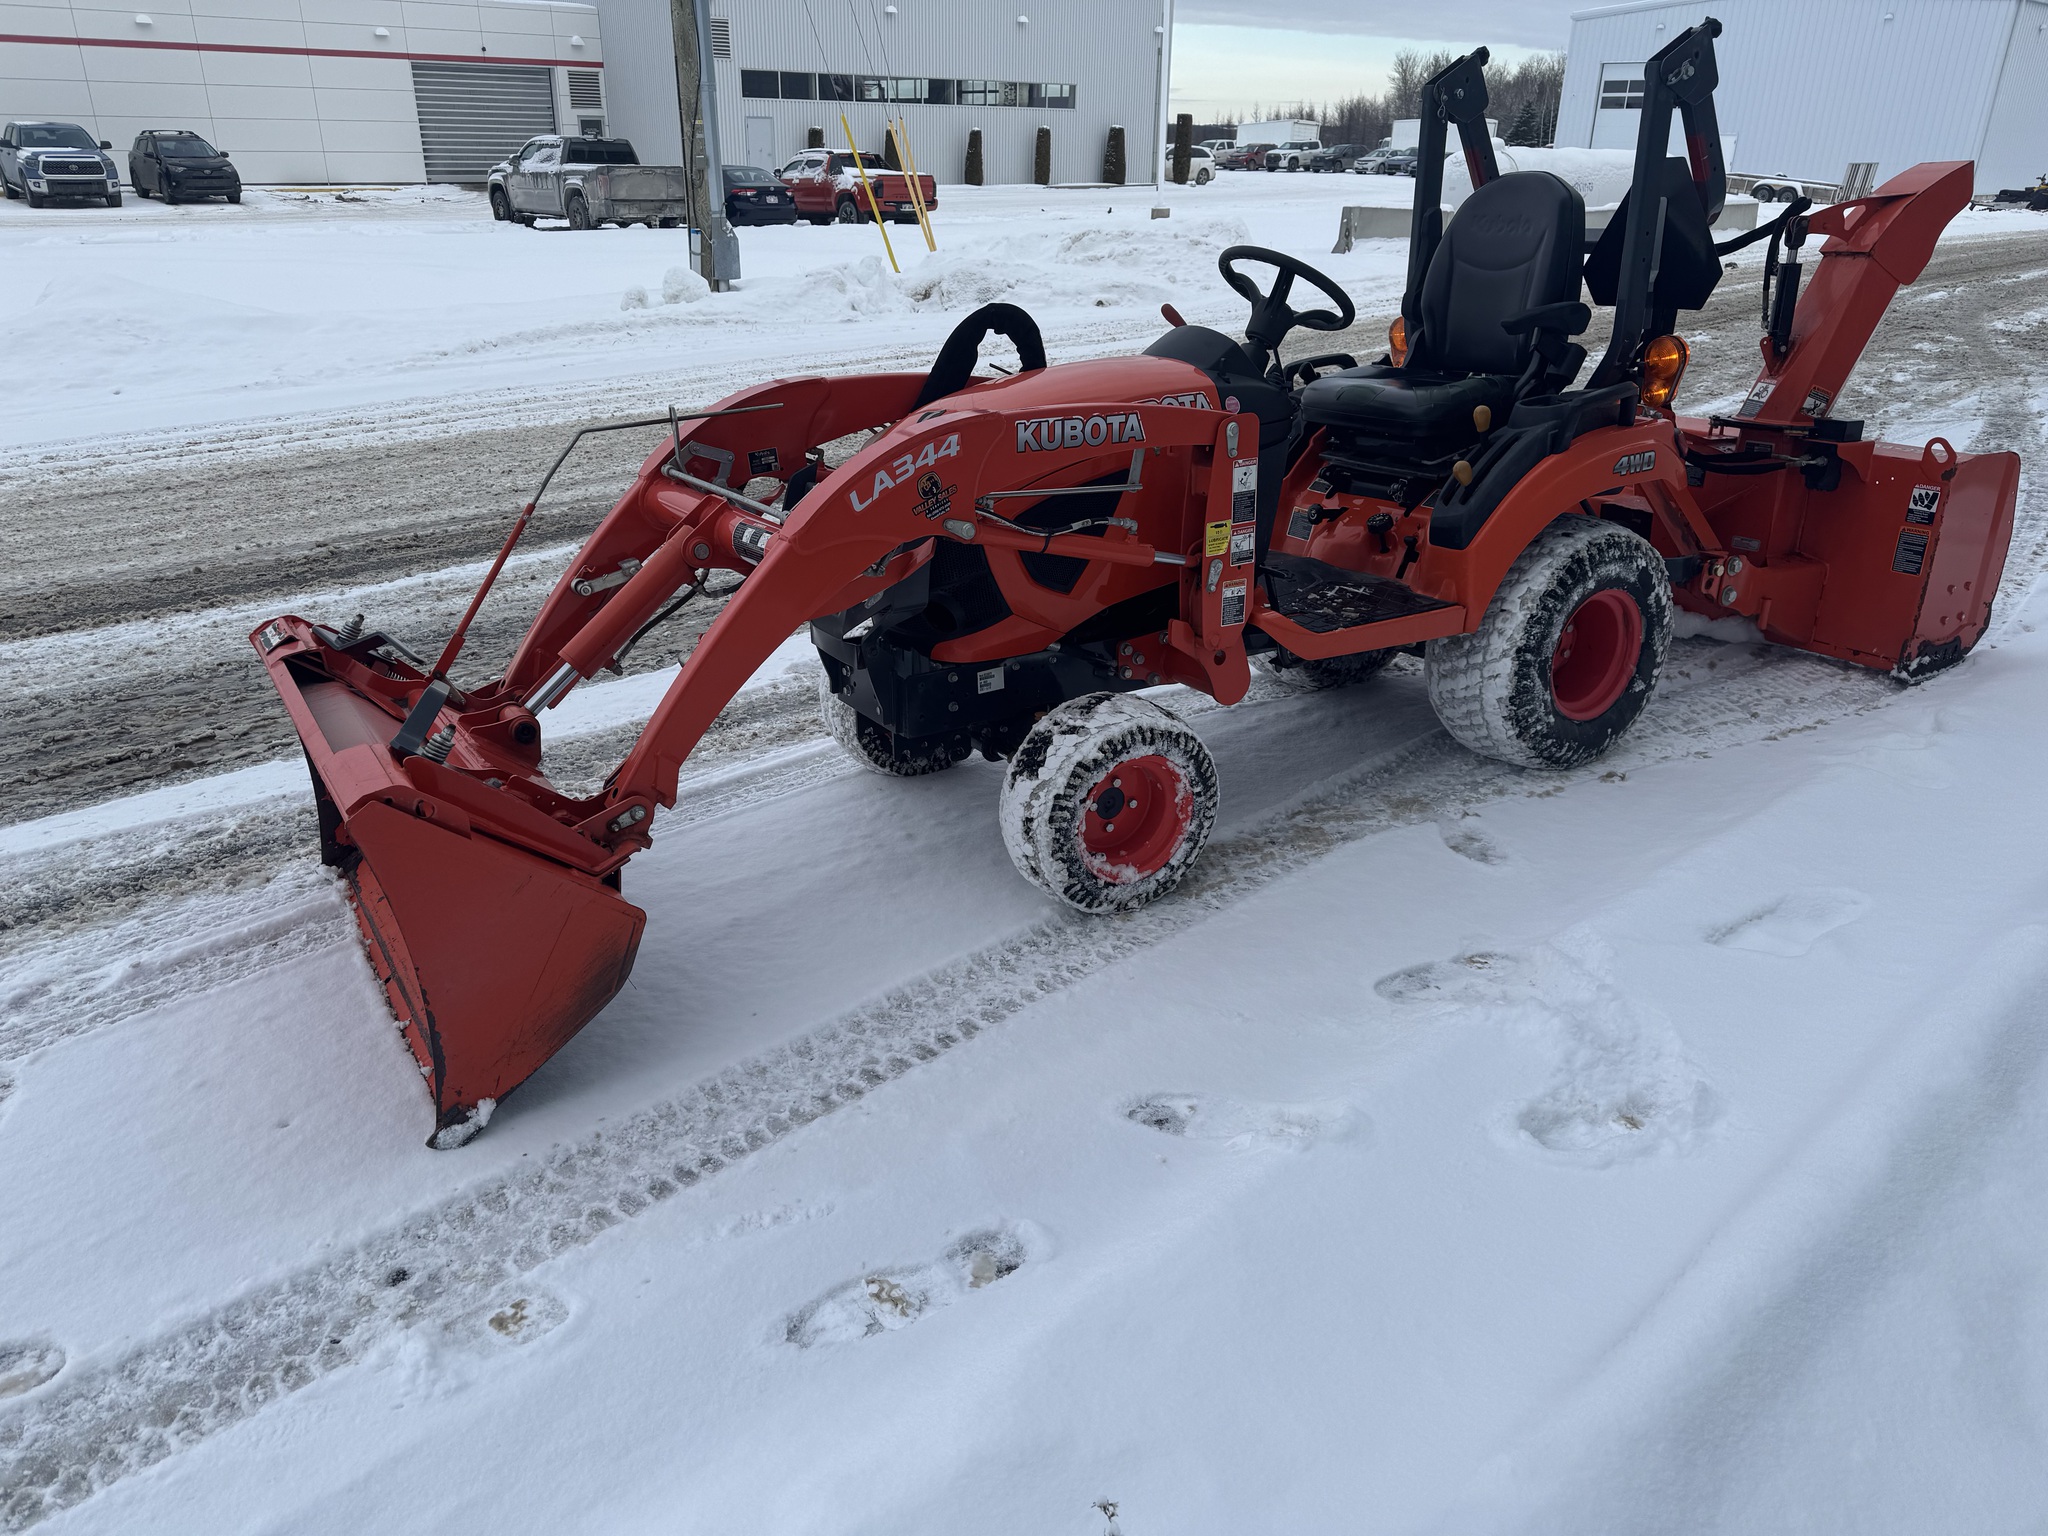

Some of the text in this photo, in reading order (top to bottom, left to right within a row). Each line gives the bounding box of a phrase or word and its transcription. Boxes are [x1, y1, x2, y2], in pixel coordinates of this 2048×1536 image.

[1017, 413, 1144, 452] KUBOTA
[849, 434, 960, 512] LA344
[1613, 450, 1656, 476] 4WD
[913, 497, 937, 515] VALLEY
[938, 485, 957, 501] SALES
[1920, 483, 1941, 491] DANGER
[1906, 527, 1930, 536] WARNING
